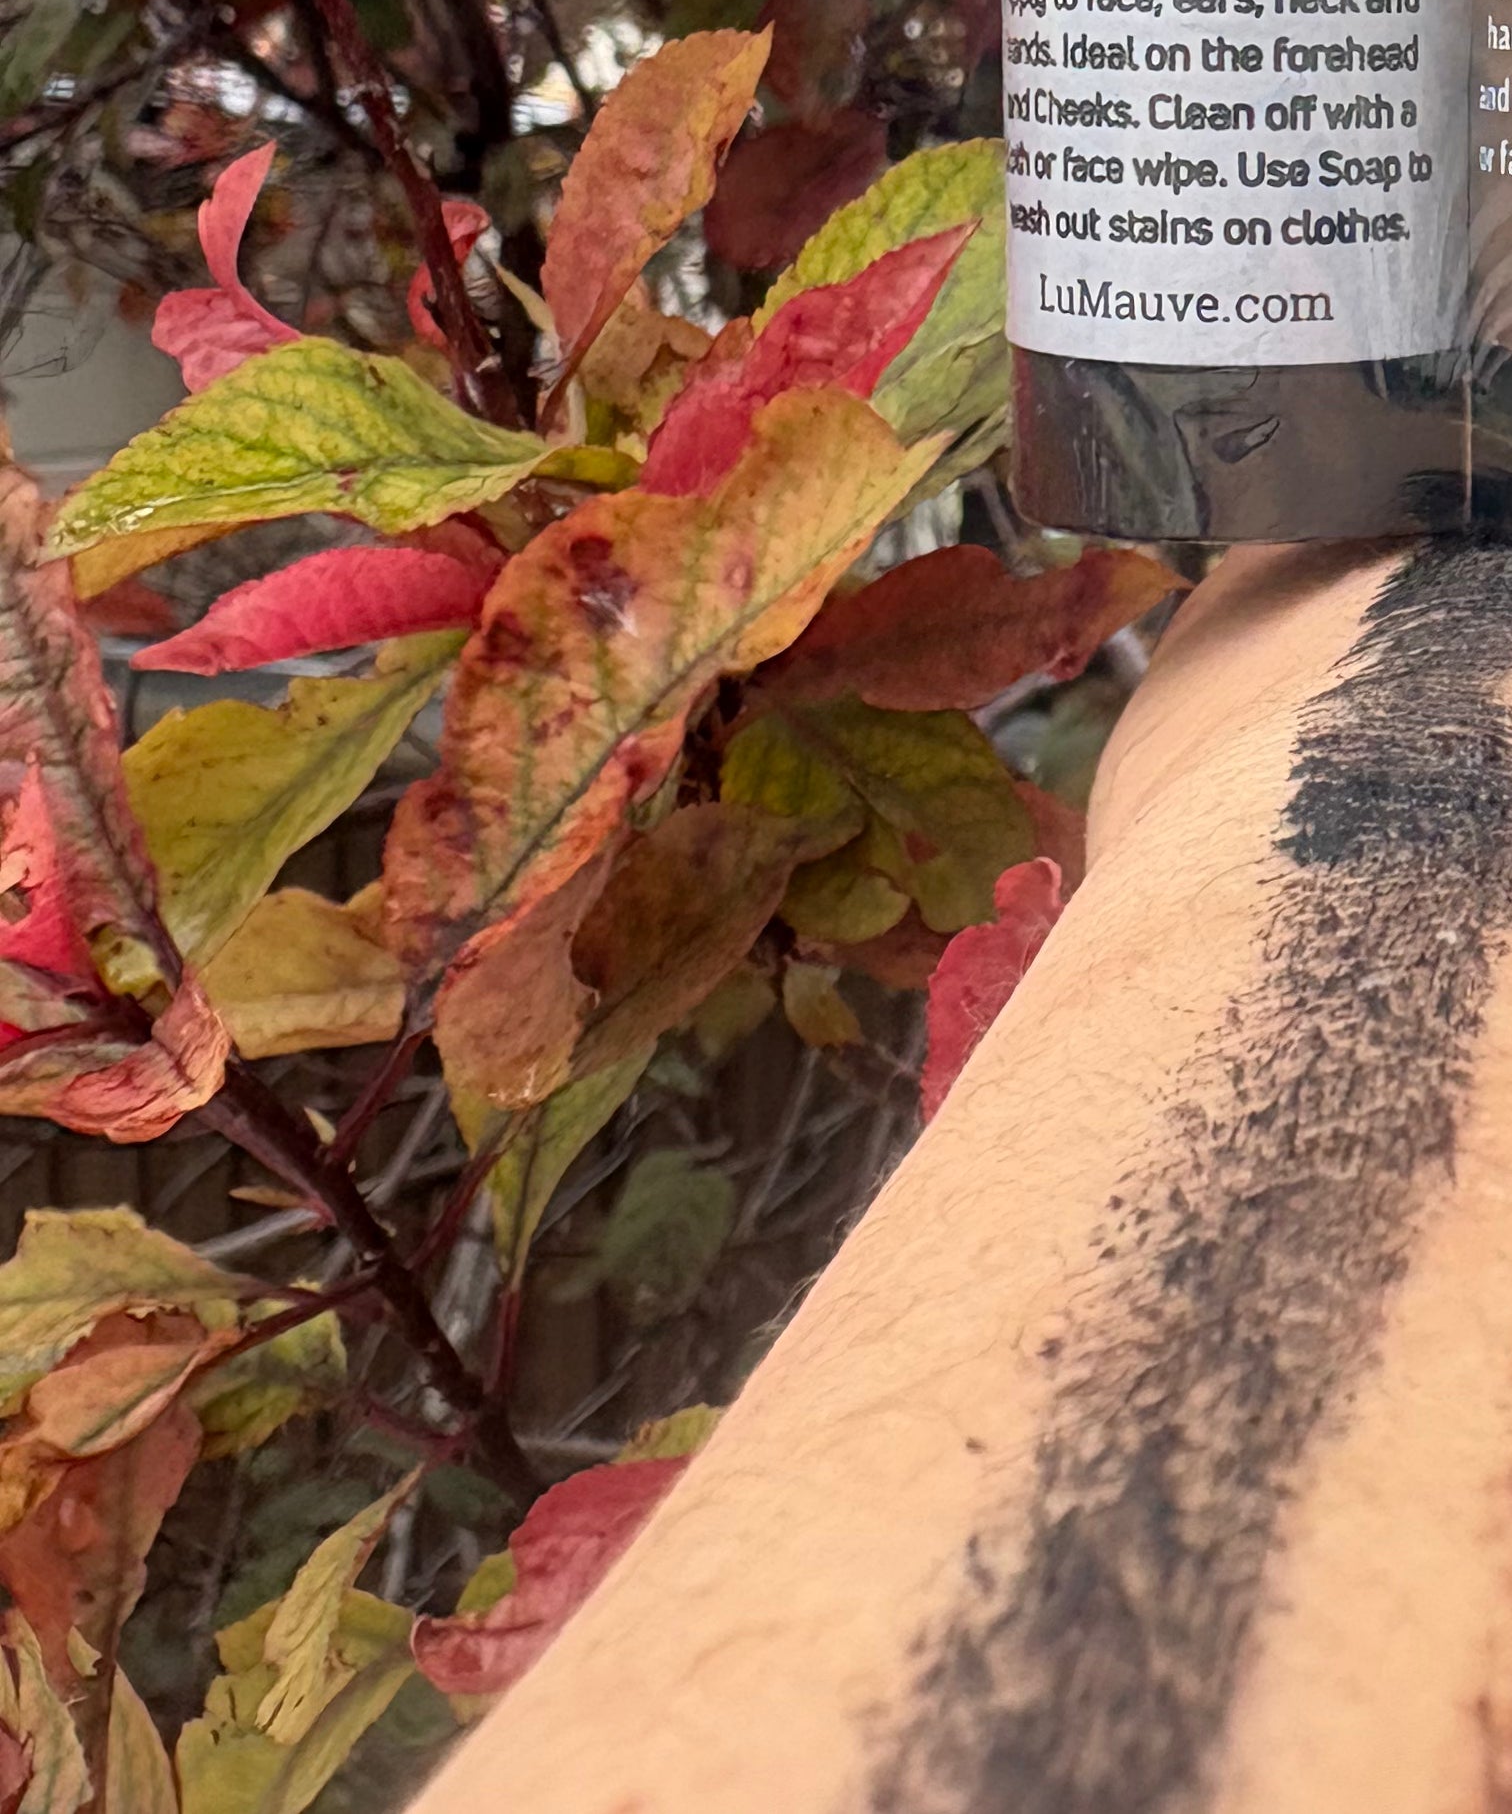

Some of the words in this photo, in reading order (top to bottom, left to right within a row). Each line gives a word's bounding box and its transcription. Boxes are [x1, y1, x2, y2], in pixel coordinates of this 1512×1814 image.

[1007, 31, 1057, 66] ands.
[1063, 32, 1140, 71] Ideal
[1144, 44, 1191, 72] on
[1201, 36, 1263, 72] the
[1273, 34, 1419, 72] forehead
[1007, 87, 1030, 122] nd
[1034, 88, 1140, 129] Cheeks.
[1148, 93, 1255, 131] Clean
[1265, 94, 1317, 131] off
[1323, 94, 1395, 130] with
[1400, 100, 1417, 128] a
[1479, 76, 1510, 112] and
[1034, 150, 1057, 179] or
[1063, 146, 1123, 183] face
[1133, 151, 1227, 195] wipe.
[1238, 152, 1309, 187] Use
[1318, 150, 1401, 192] Soap
[1409, 150, 1432, 183] to
[1056, 207, 1101, 241] out
[1109, 209, 1214, 246] stains
[1223, 216, 1272, 246] on
[1280, 208, 1410, 245] clothes.
[1040, 273, 1334, 323] LuMauve.com
